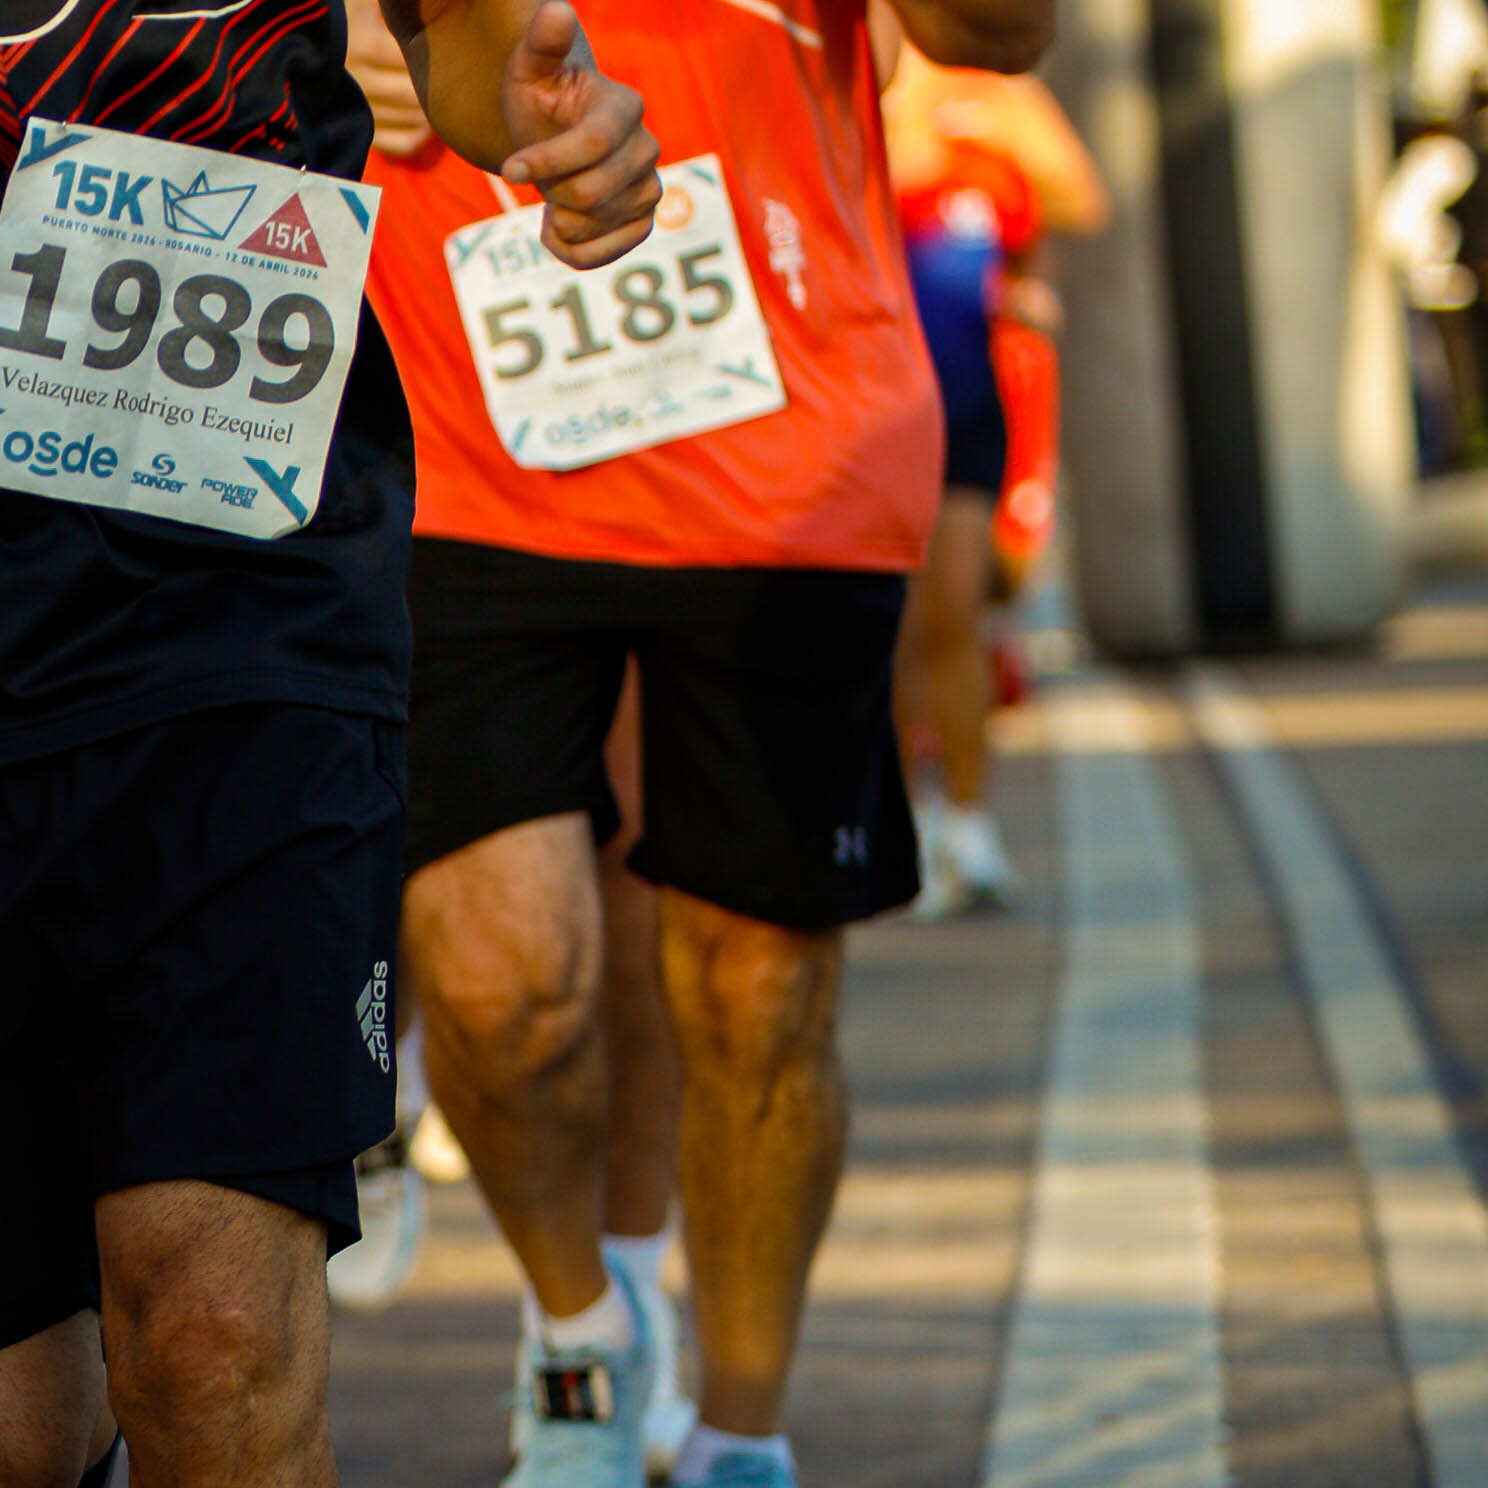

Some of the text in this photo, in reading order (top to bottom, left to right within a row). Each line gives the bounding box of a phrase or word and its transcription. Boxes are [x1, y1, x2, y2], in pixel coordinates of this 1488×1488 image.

[51, 159, 155, 226] 15K
[42, 215, 88, 233] PUERTO
[92, 225, 128, 241] NORTE
[165, 238, 213, 257] ROSARIO
[225, 252, 238, 263] 12
[241, 255, 256, 267] DE
[258, 258, 290, 275] ABRIL
[265, 220, 312, 256] 15K
[481, 242, 736, 382] 5185
[1, 366, 295, 445] Velazquez Rodrigo Ezequiel
[2, 430, 118, 479] osde
[370, 960, 390, 1074] adidas
